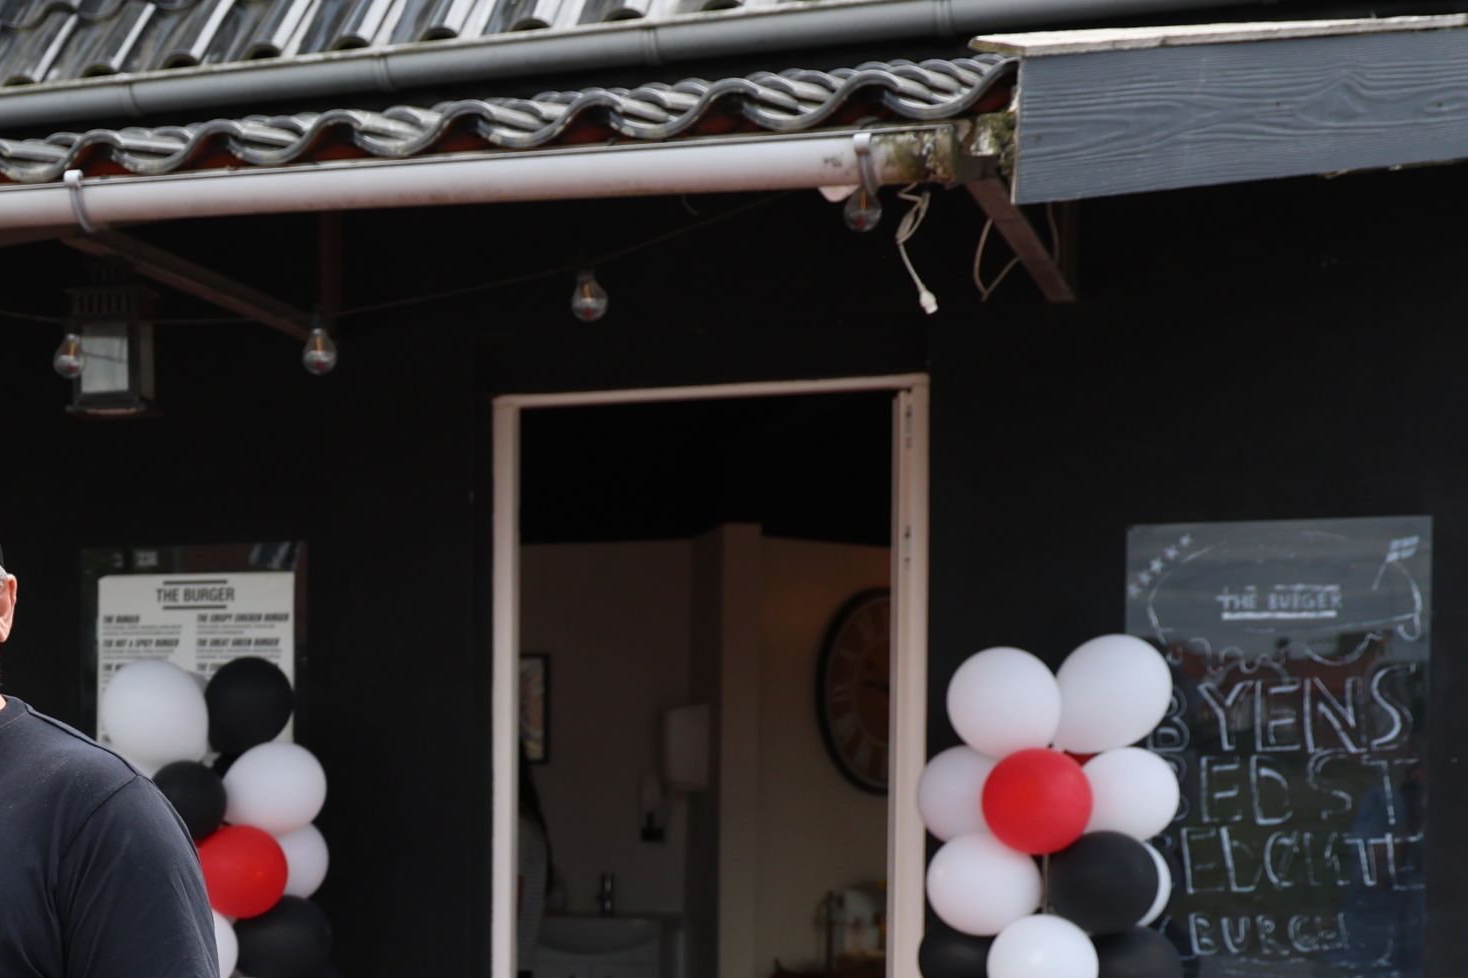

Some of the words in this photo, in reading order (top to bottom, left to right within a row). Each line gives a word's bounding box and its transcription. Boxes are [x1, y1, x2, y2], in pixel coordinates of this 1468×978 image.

[156, 588, 179, 603] THE
[183, 587, 235, 603] BURGER
[1216, 586, 1258, 610] THE
[1267, 591, 1343, 610] BURGER
